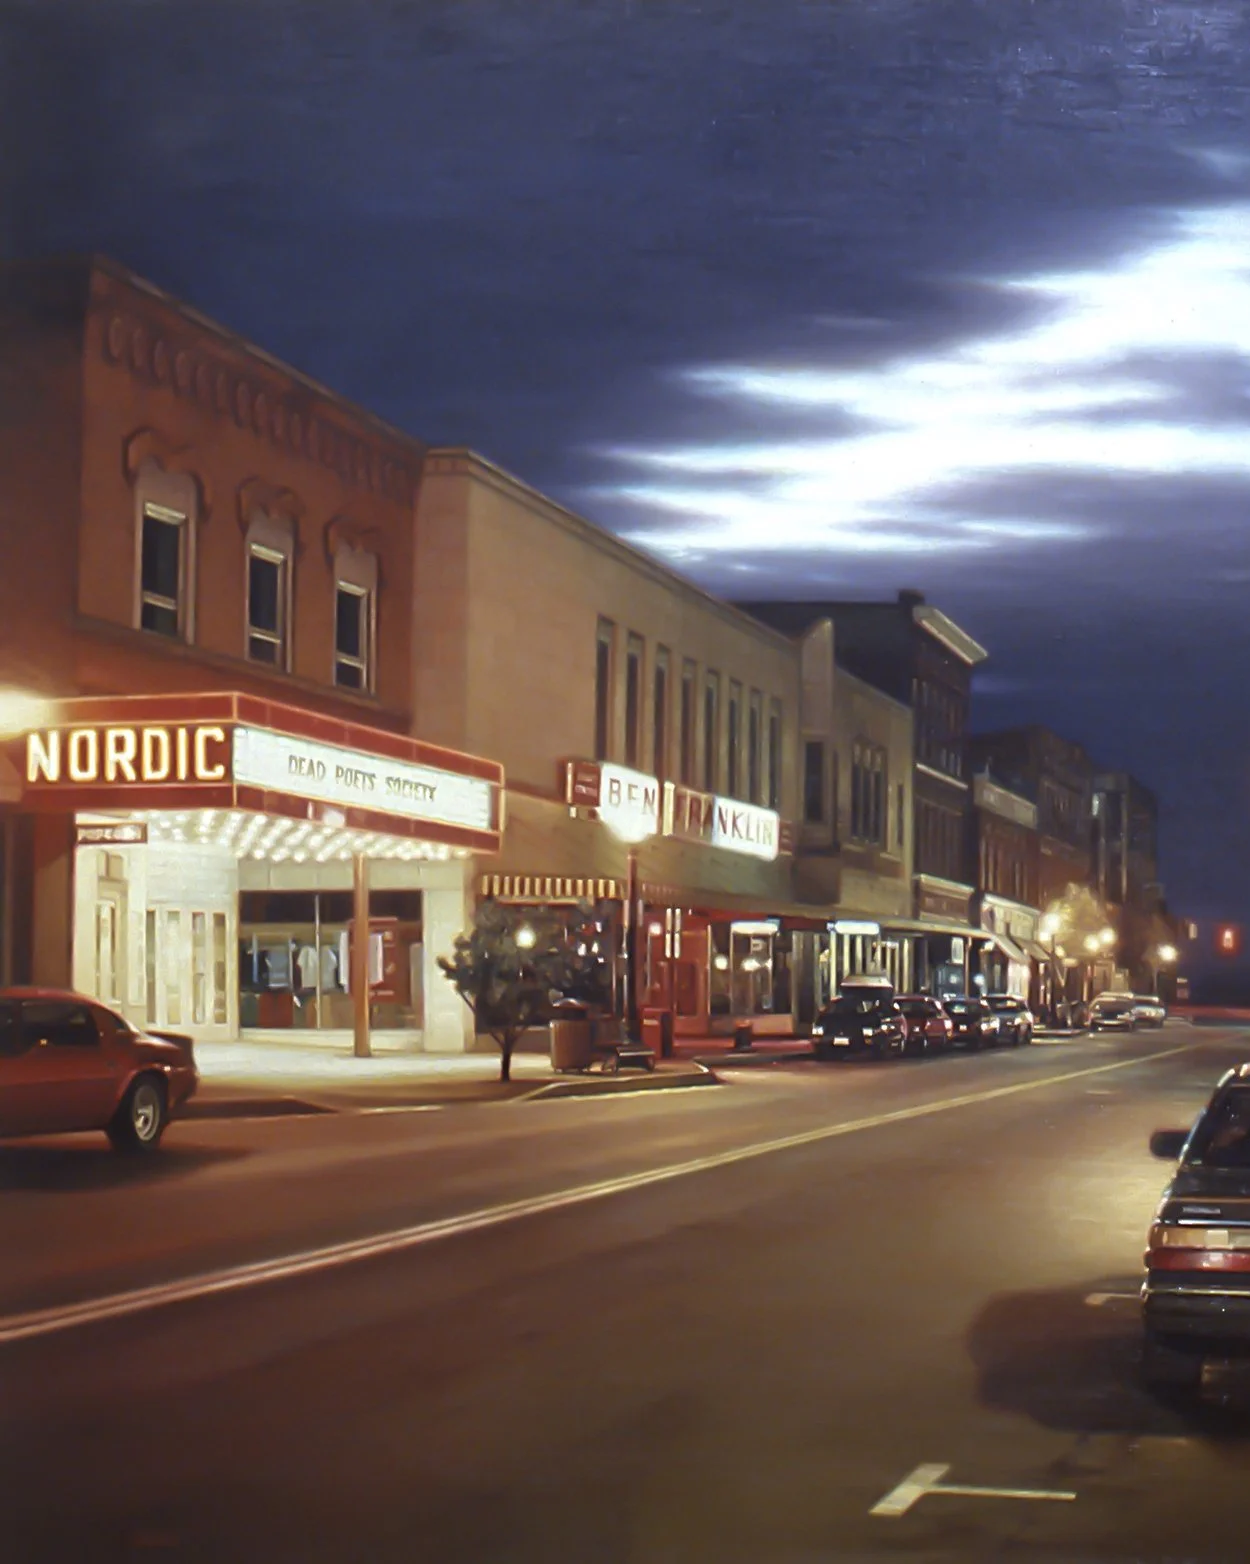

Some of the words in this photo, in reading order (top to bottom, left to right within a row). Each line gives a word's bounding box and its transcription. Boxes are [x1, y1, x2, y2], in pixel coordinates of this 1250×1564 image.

[26, 726, 226, 783] NORDIC
[288, 754, 327, 781] DEAD
[335, 764, 378, 792] POETS
[608, 777, 656, 816] BEN
